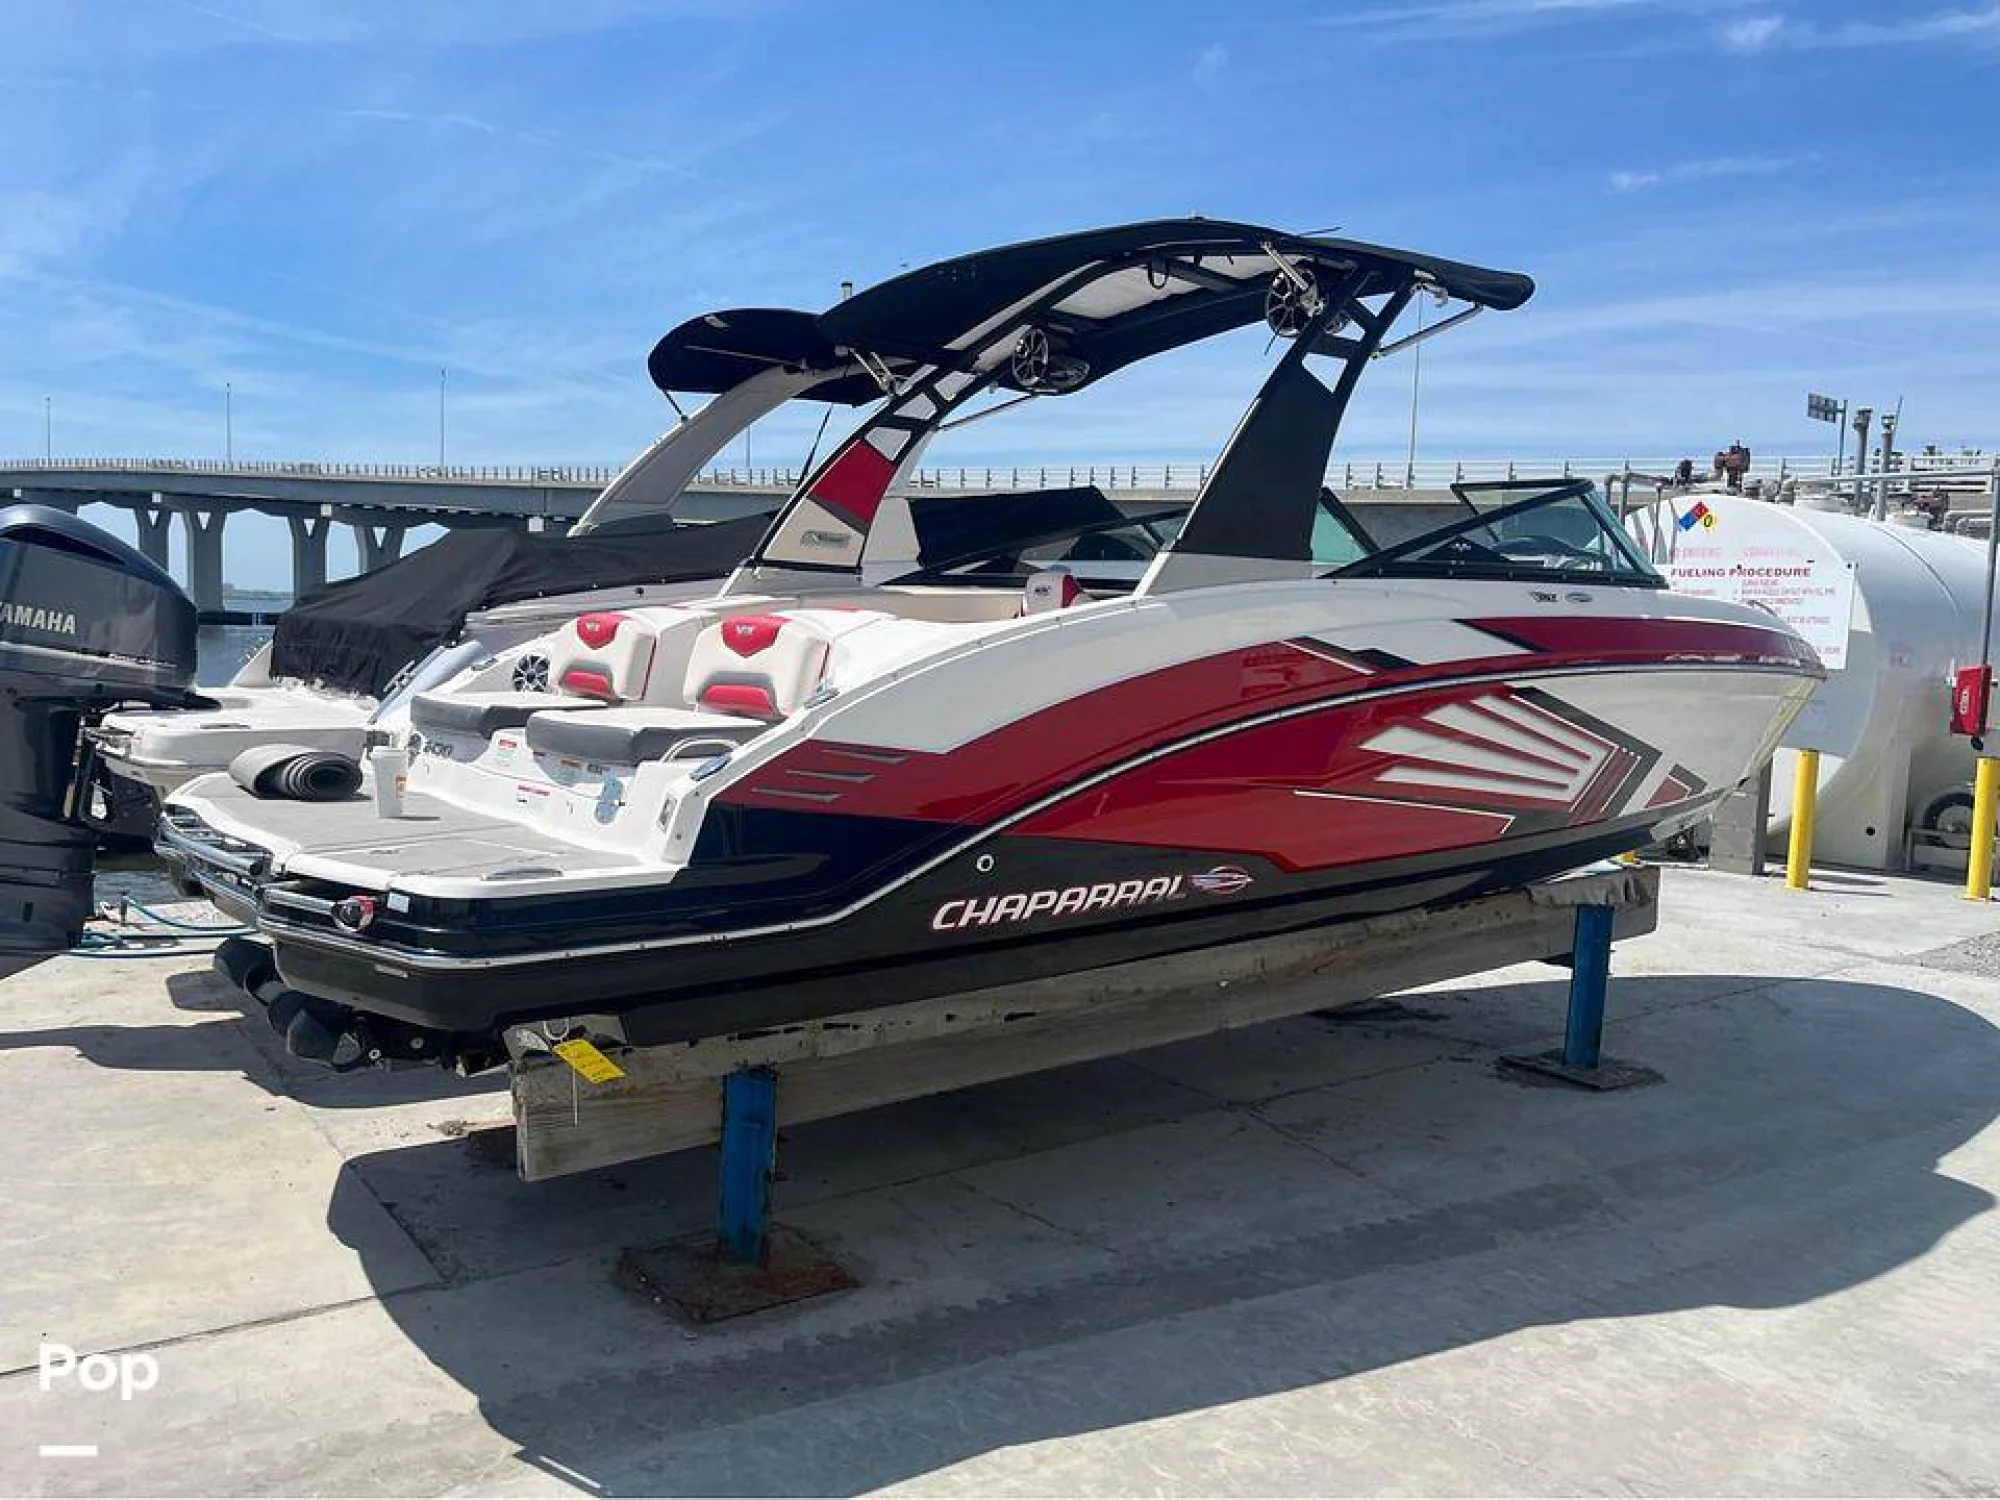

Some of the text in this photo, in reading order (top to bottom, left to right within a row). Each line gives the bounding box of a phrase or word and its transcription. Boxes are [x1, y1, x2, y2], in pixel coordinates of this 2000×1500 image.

[1671, 568, 1725, 577] FUELING
[0, 602, 75, 635] AMAHA
[931, 875, 1187, 930] CHAPARRAL
